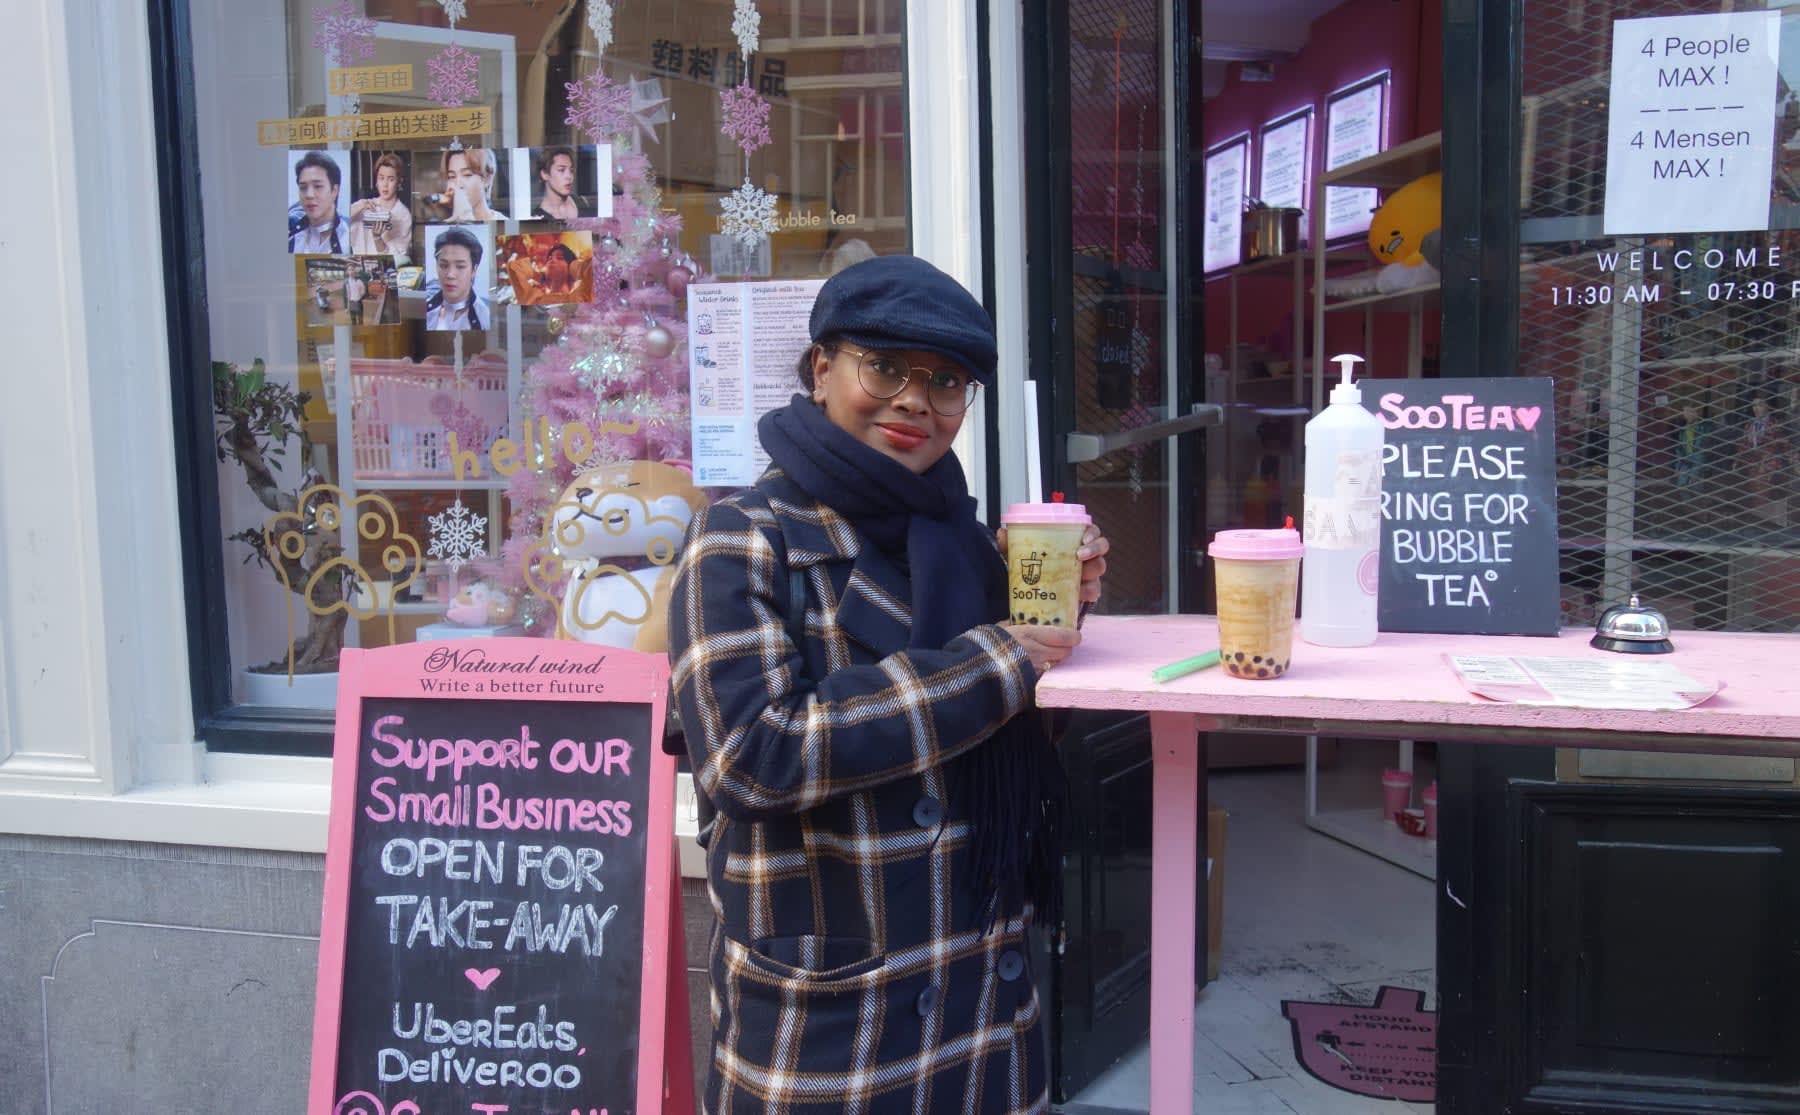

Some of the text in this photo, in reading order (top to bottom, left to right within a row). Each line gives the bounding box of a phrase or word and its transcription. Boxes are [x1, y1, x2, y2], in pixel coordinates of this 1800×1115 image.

[1640, 33, 1751, 59] 4 People
[1658, 66, 1716, 88] MAX
[1630, 129, 1751, 149] 4 Mensen
[1653, 158, 1711, 179] MAX
[773, 209, 821, 227] ubble
[830, 209, 856, 225] tea
[1597, 246, 1781, 272] WELCOME
[1551, 286, 1612, 306] 11:30
[1623, 284, 1660, 303] AM
[1707, 281, 1775, 301] 07:30
[1381, 444, 1528, 480] PLEASE
[1381, 492, 1529, 525] RING FOR
[1393, 529, 1513, 564] BUBBLE
[1012, 586, 1057, 601] SooTea
[423, 647, 606, 674] Natural wind
[419, 678, 605, 695] Write a better future
[364, 776, 471, 824] Small
[380, 837, 604, 893] OPEN FOR
[375, 894, 618, 957] TAKE-AWAY
[1340, 1020, 1433, 1033] AFSTAND
[1354, 1013, 1412, 1024] HOUD
[1340, 1064, 1393, 1075] KEEP
